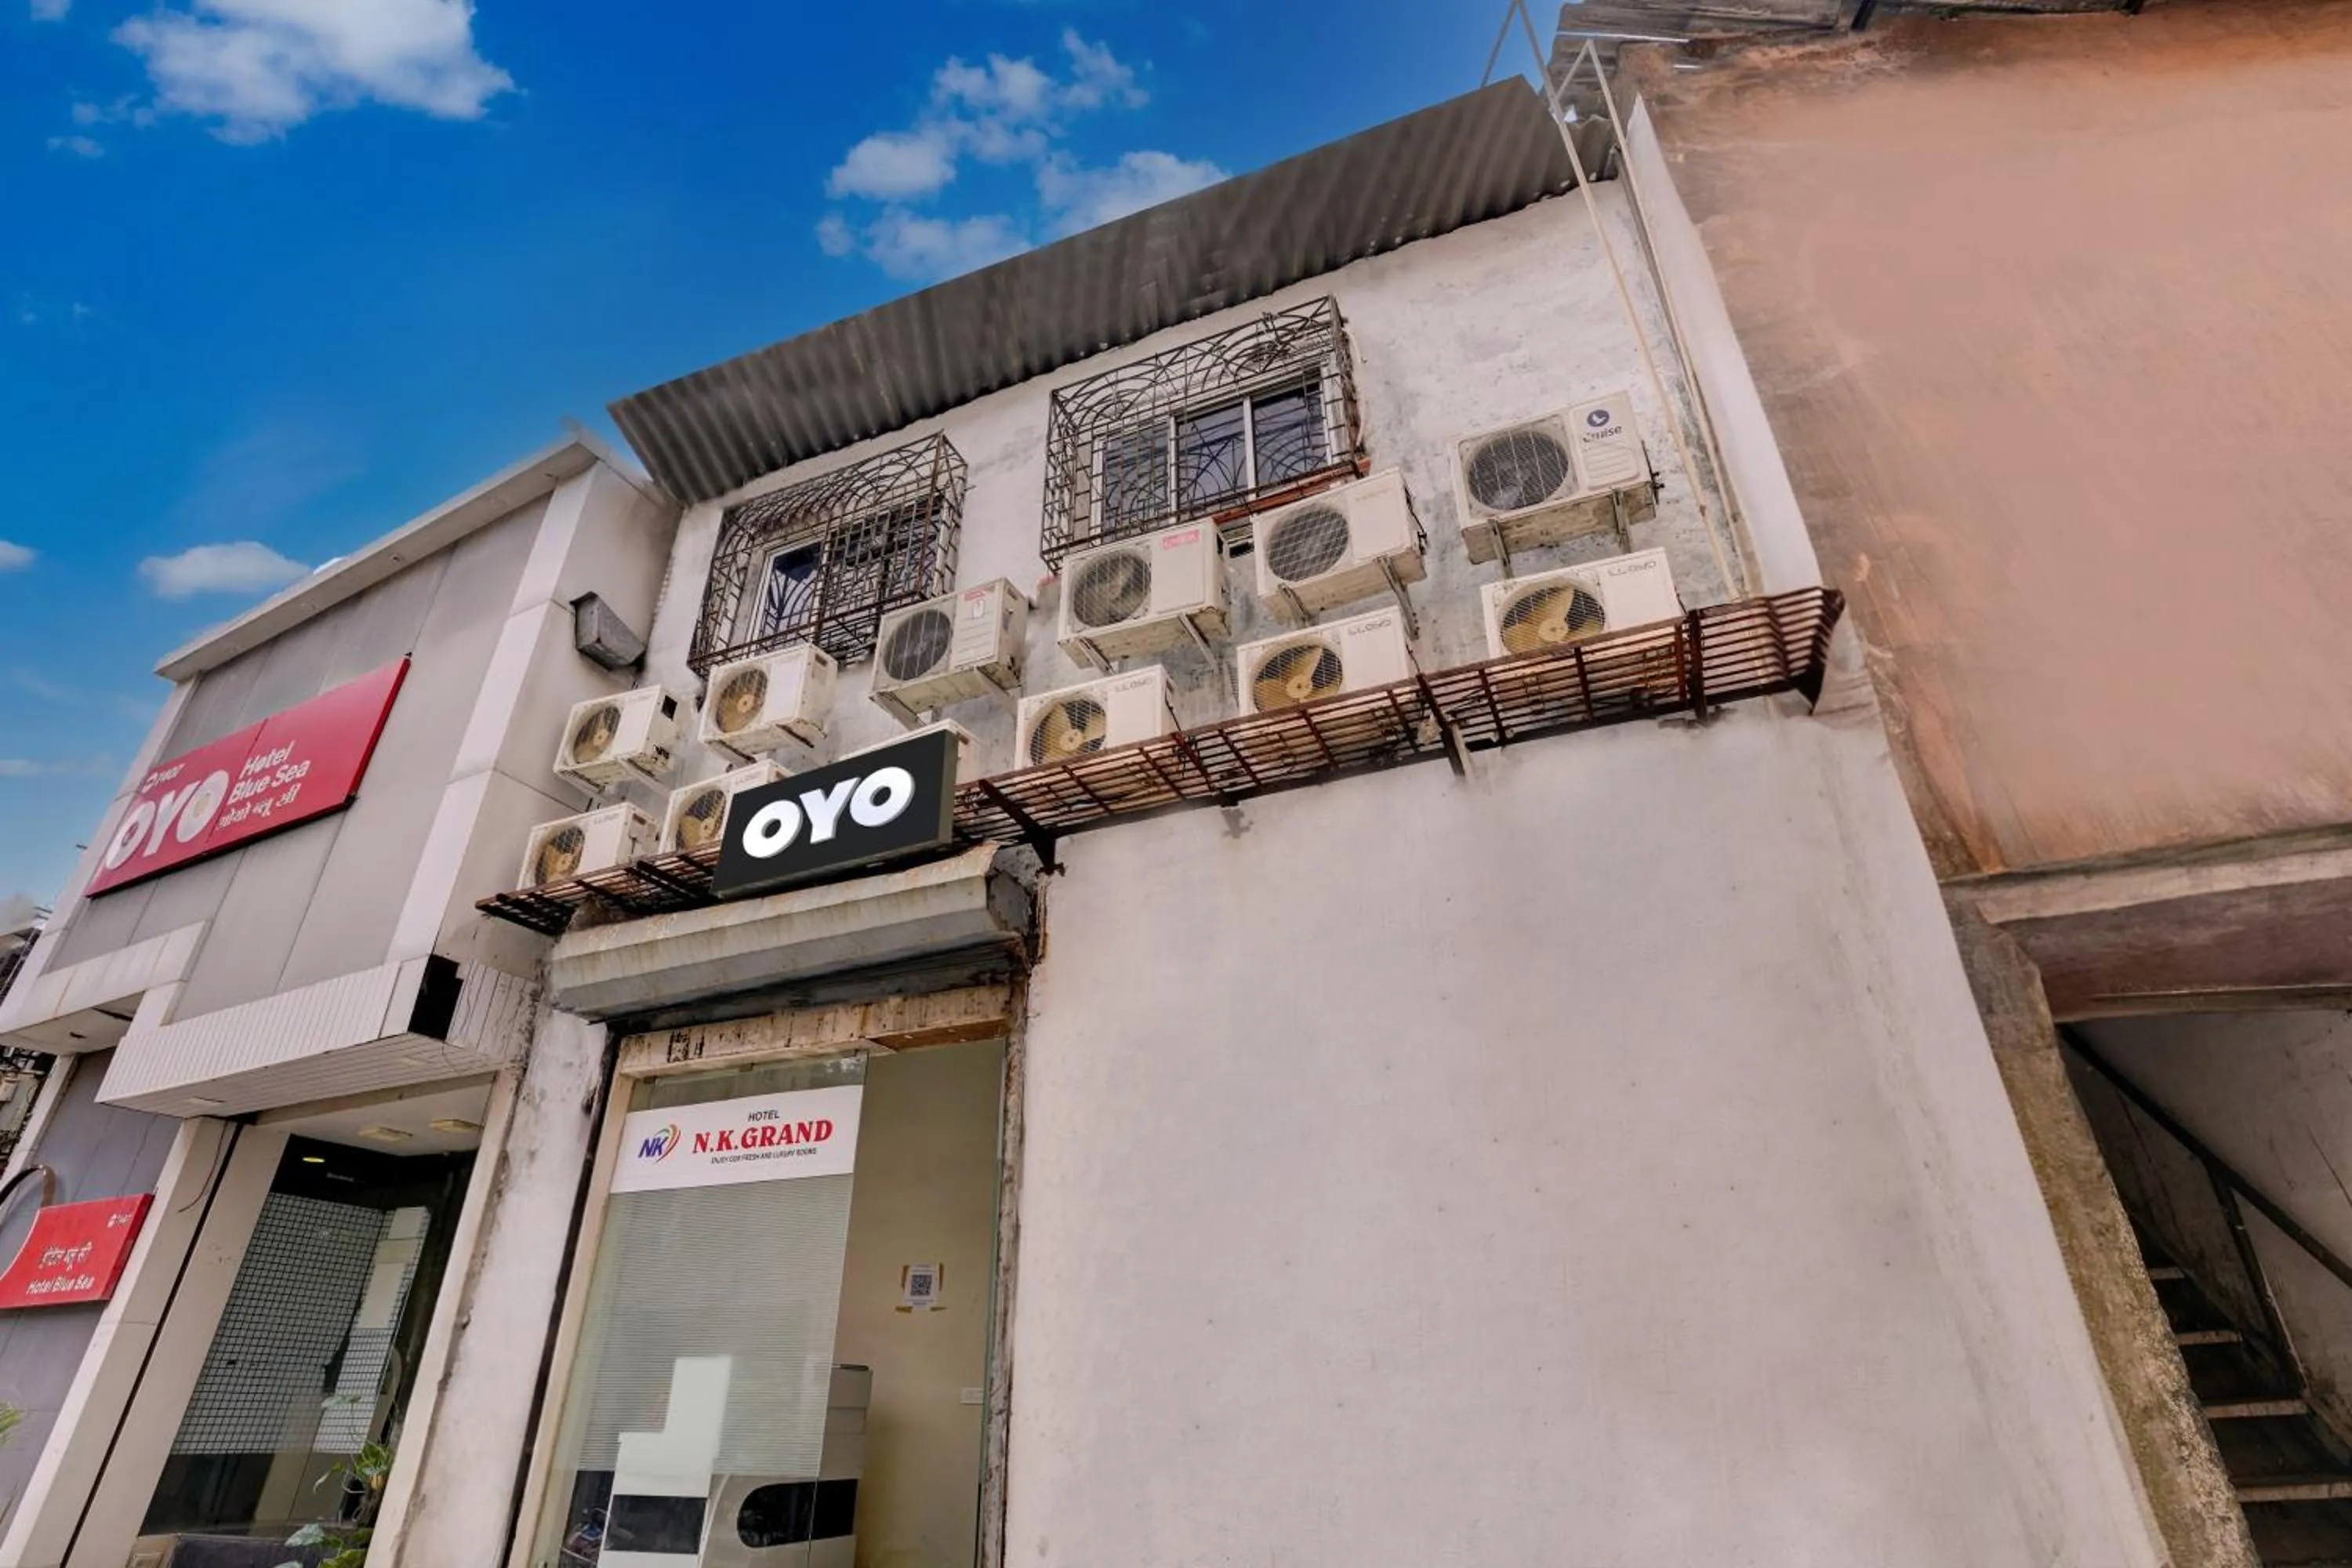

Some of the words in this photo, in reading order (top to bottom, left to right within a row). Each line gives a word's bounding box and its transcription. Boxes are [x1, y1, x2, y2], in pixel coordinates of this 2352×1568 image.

[239, 740, 295, 779] Hotel
[227, 775, 270, 805] Blue
[272, 760, 310, 788] Sea
[105, 769, 230, 870] OYO
[742, 766, 916, 859] OYO
[747, 1110, 780, 1121] HOTEL
[638, 1137, 667, 1158] NK
